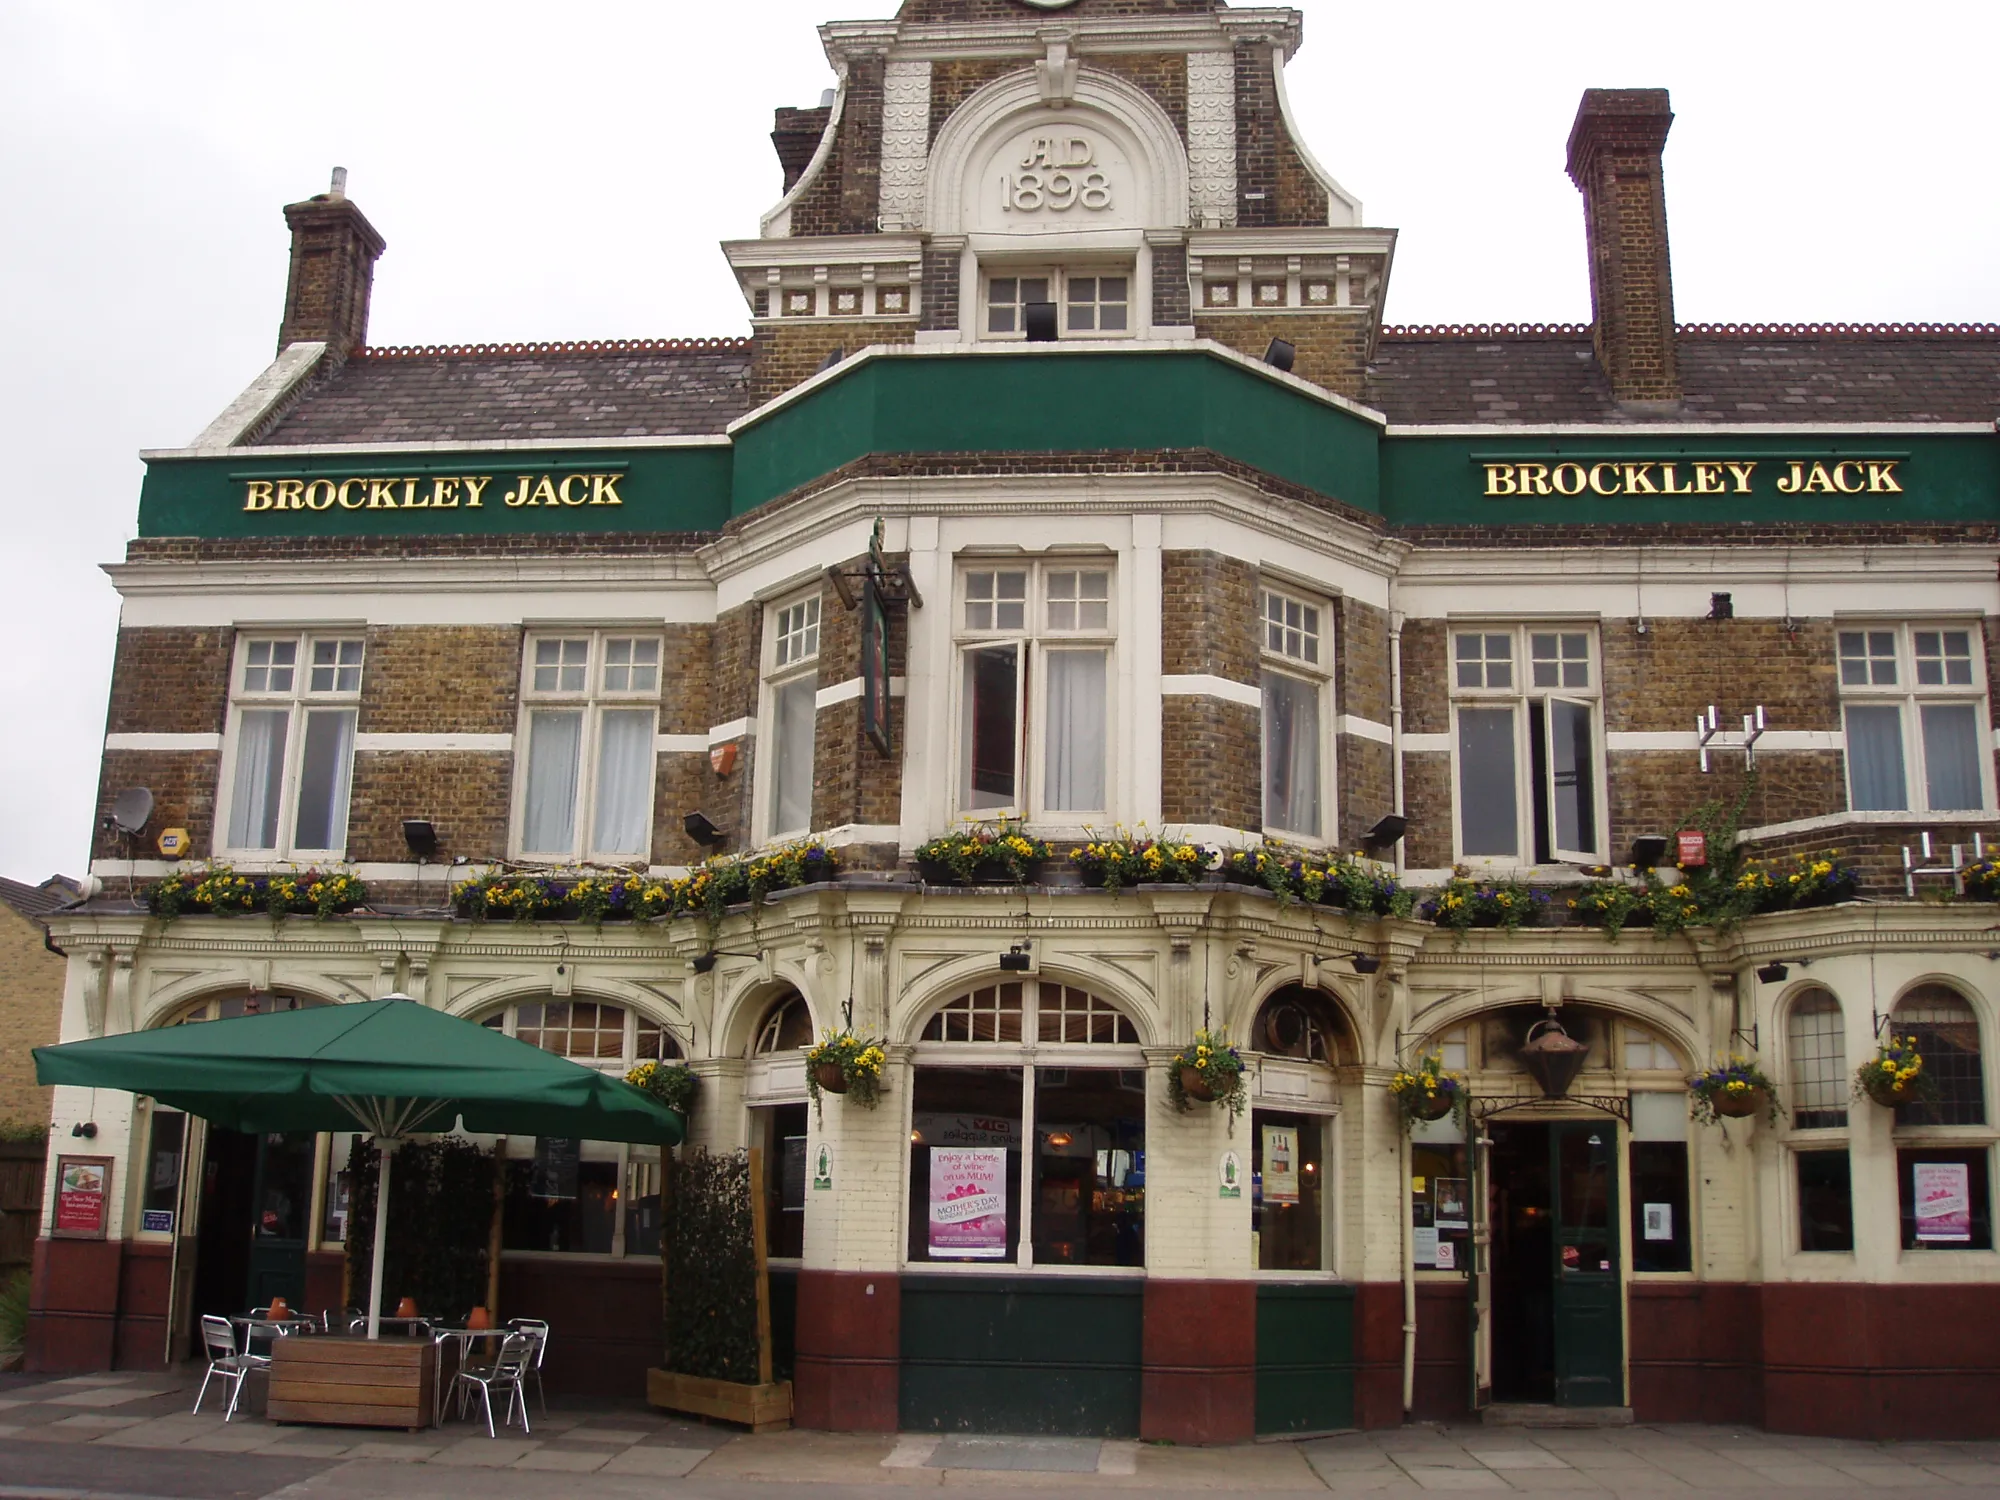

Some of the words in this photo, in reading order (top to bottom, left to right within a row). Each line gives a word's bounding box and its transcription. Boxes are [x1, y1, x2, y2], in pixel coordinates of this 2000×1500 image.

[1483, 461, 1757, 496] BROCKLEY
[1777, 460, 1903, 494] JACK
[243, 476, 492, 512] BROCKLEY
[504, 473, 624, 508] JACK
[938, 1153, 963, 1163] Enjoy
[973, 1153, 999, 1162] bottle
[967, 1172, 994, 1181] MUM!
[937, 1200, 980, 1215] MOTHER'S
[981, 1195, 998, 1205] DAY
